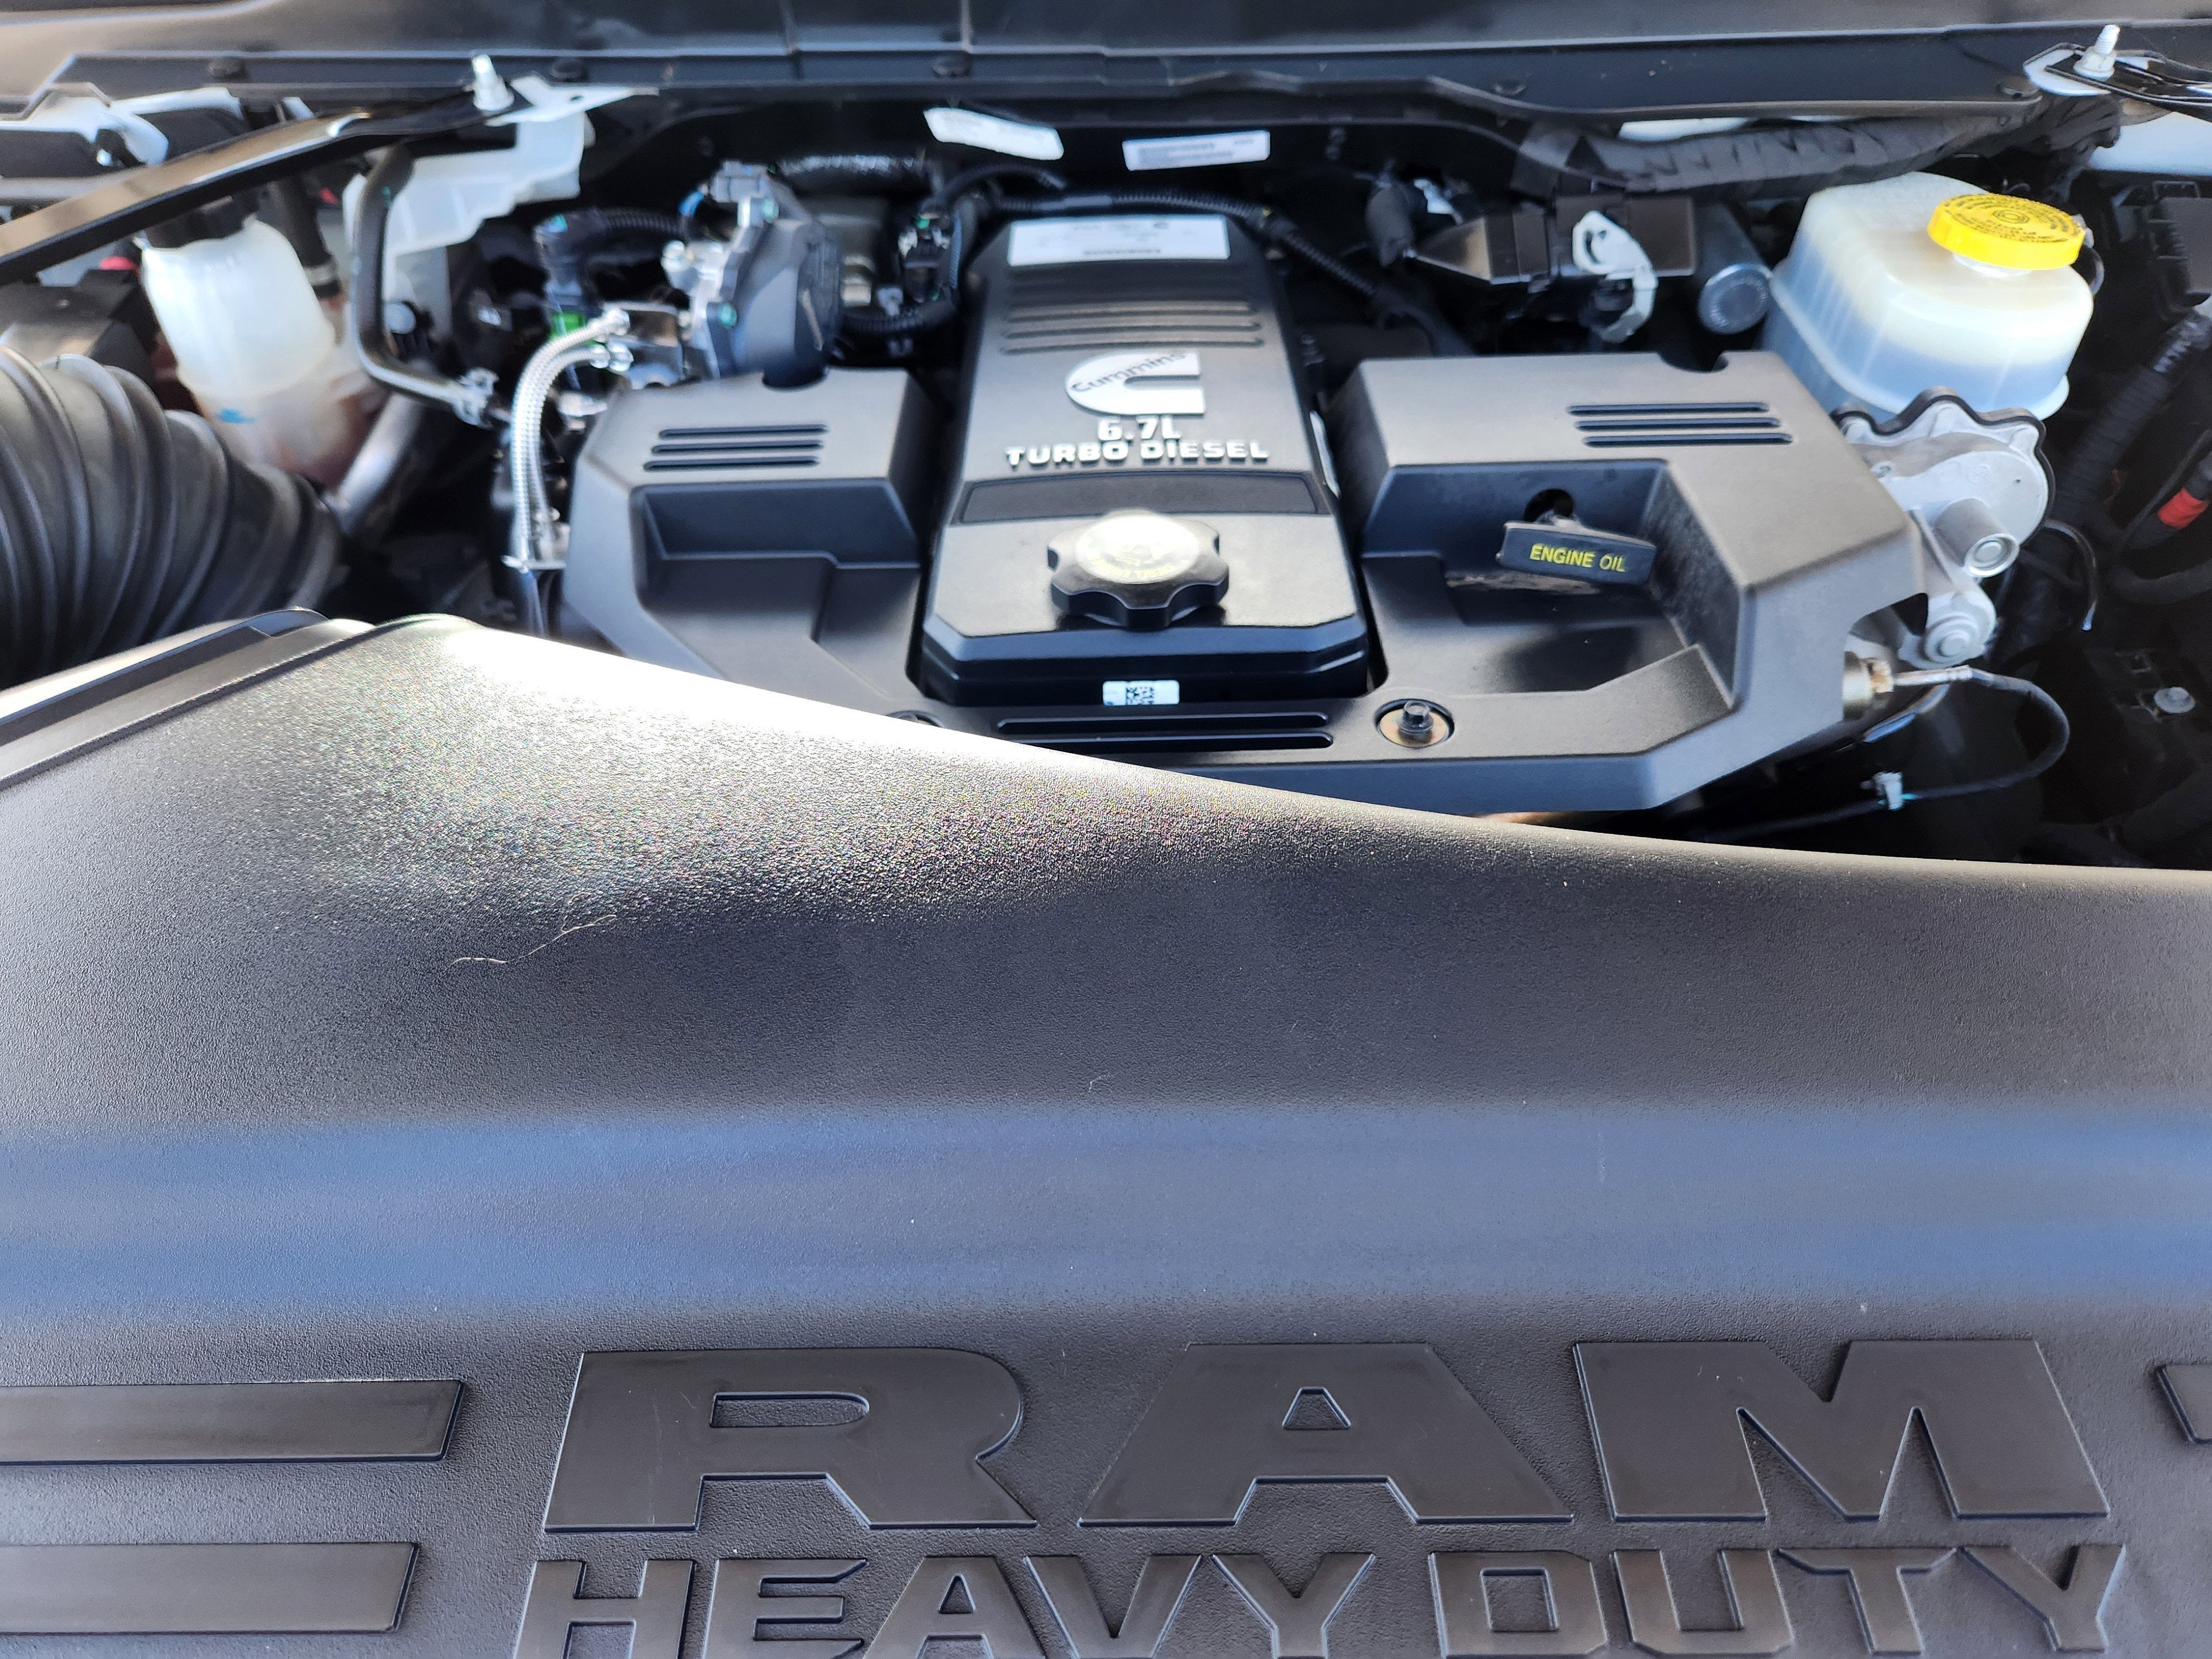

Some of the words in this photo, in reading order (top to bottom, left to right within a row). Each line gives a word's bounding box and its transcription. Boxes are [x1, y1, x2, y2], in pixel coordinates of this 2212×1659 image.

[1071, 351, 1187, 393] Cummins
[1097, 415, 1183, 442] 6.7L
[1005, 442, 1129, 467] TURBO
[1140, 440, 1270, 463] DIESEL
[1530, 543, 1594, 568] ENGINE
[1599, 554, 1627, 573] OIL
[542, 1339, 2110, 1530] RAM
[509, 1553, 1378, 1659] HEAVY
[1427, 1544, 2126, 1659] DUTY
